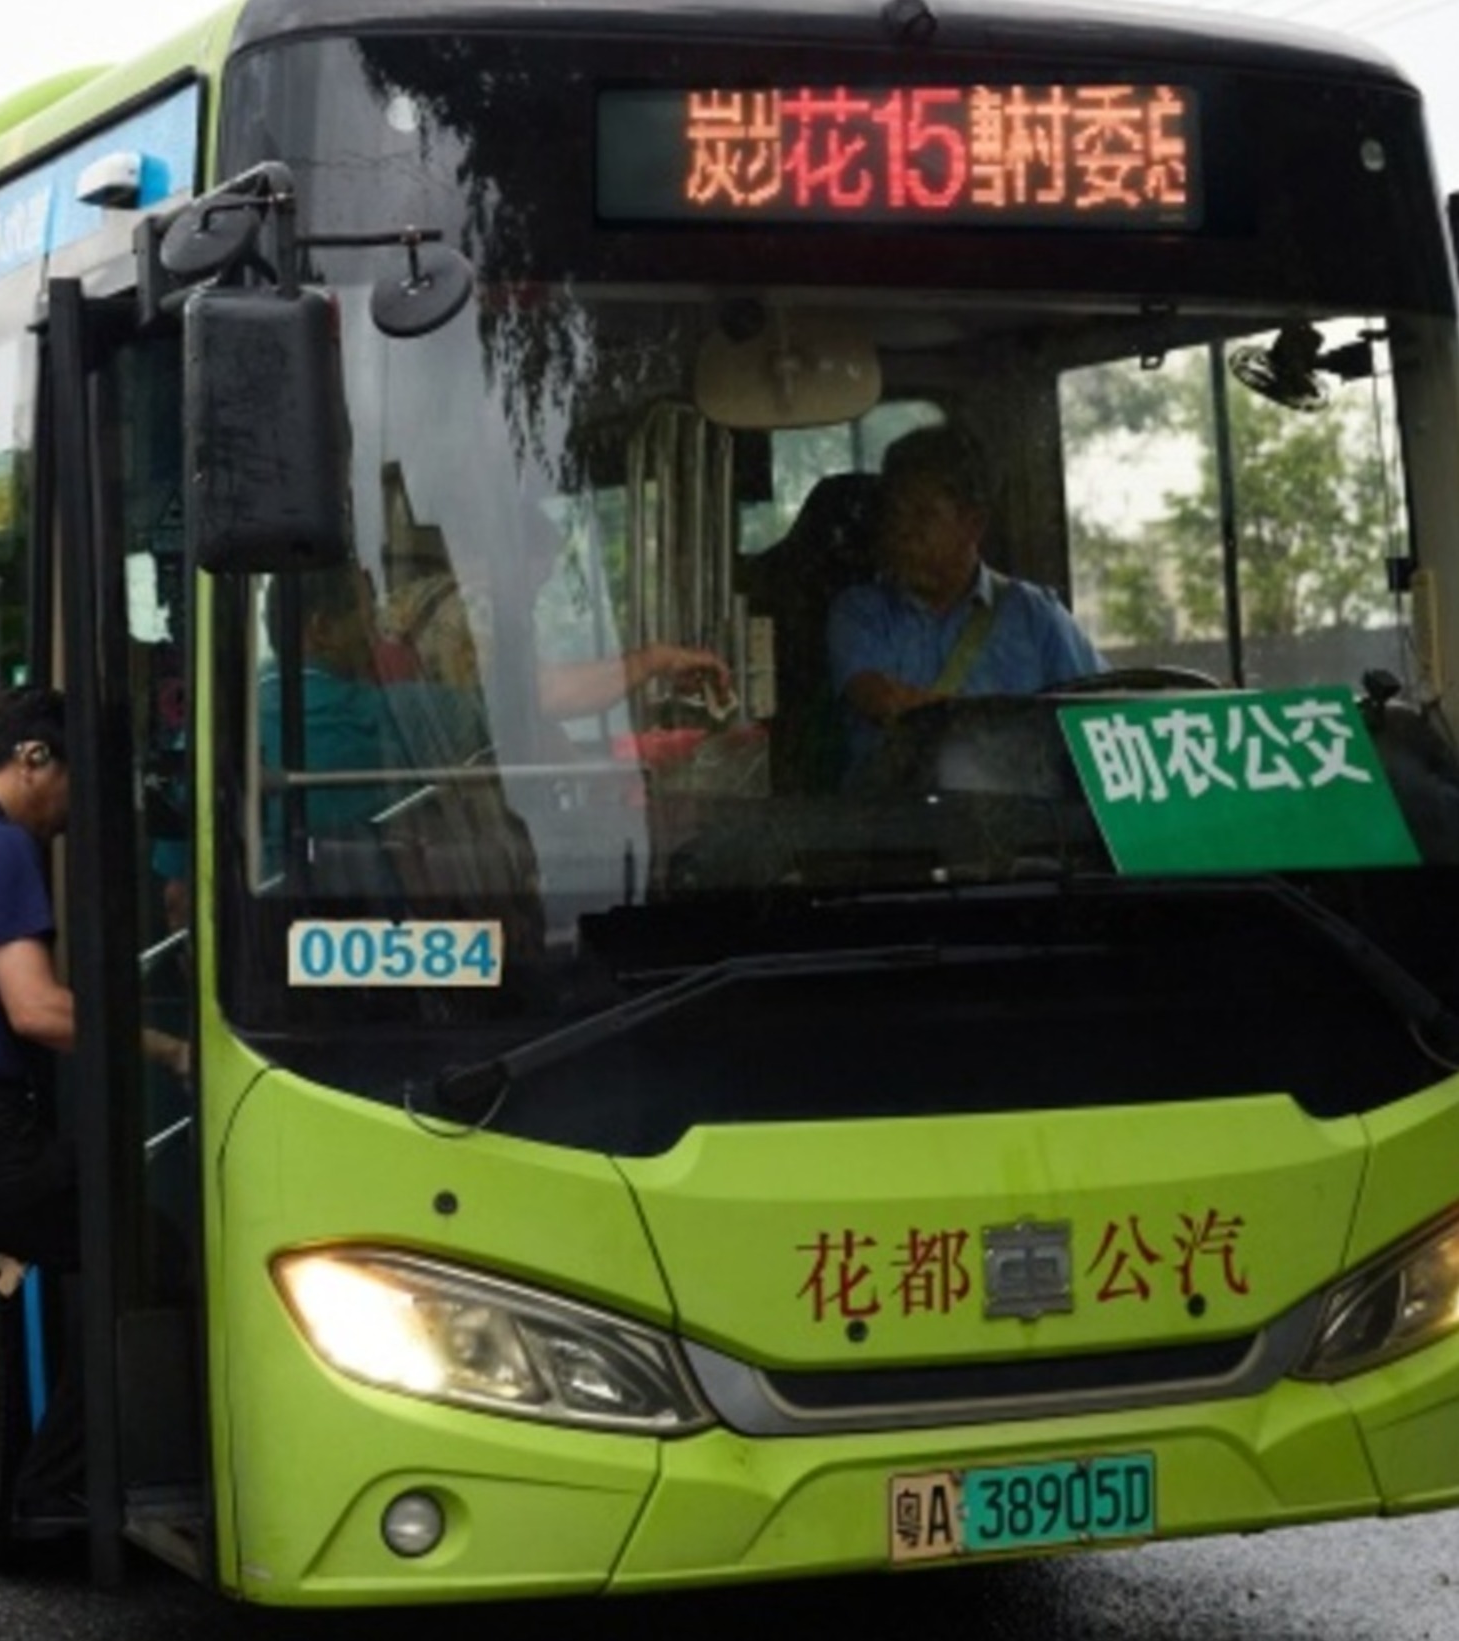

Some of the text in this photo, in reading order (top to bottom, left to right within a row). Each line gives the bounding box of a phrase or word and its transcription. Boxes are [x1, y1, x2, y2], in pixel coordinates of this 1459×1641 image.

[1082, 700, 1373, 803] 助农公交
[300, 928, 496, 979] 00584
[796, 1208, 1249, 1322] 花都 公汽
